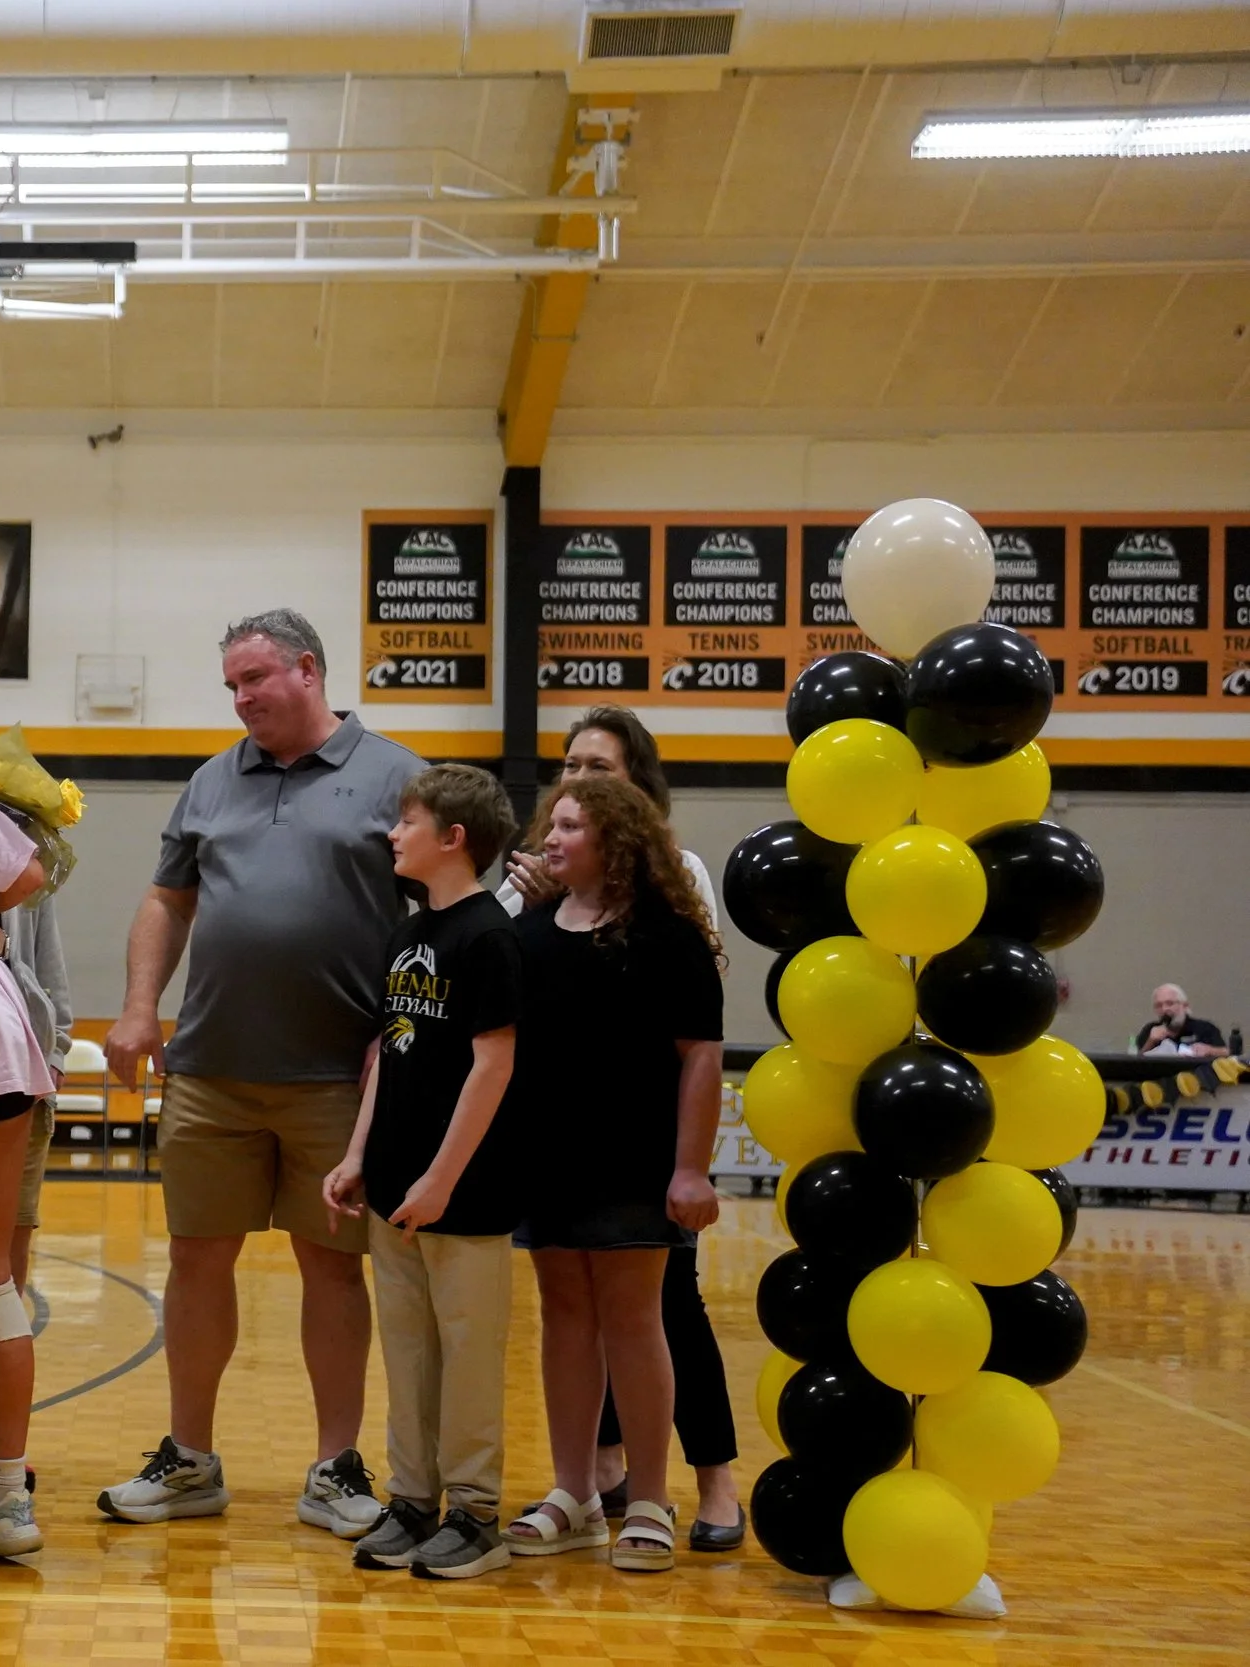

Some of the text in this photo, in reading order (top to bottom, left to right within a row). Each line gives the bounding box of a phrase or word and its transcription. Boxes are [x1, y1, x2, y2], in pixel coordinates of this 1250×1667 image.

[409, 528, 450, 547] AAC
[572, 530, 613, 549] AAC
[707, 530, 749, 549] AAC
[1125, 531, 1169, 550] AAC
[376, 580, 477, 598] CONFERENCE
[539, 582, 641, 599] CONFERENCE
[673, 582, 777, 600] CONFERENCE
[991, 584, 1055, 601] ERENCE
[1089, 584, 1199, 602] CONFERENCE
[379, 603, 474, 619] CHAMPIONS
[542, 604, 638, 621] CHAMPIONS
[676, 604, 773, 622] CHAMPIONS
[983, 606, 1052, 624] MPIONS
[1092, 607, 1195, 625] CHAMPIONS
[380, 630, 473, 648] SOFTBALL
[688, 633, 759, 650] TENNIS
[1093, 636, 1193, 654] SOFTBALL
[401, 660, 457, 684] 2021
[563, 661, 623, 685] 2018
[698, 662, 758, 686] 2018
[1115, 666, 1179, 690] 2019
